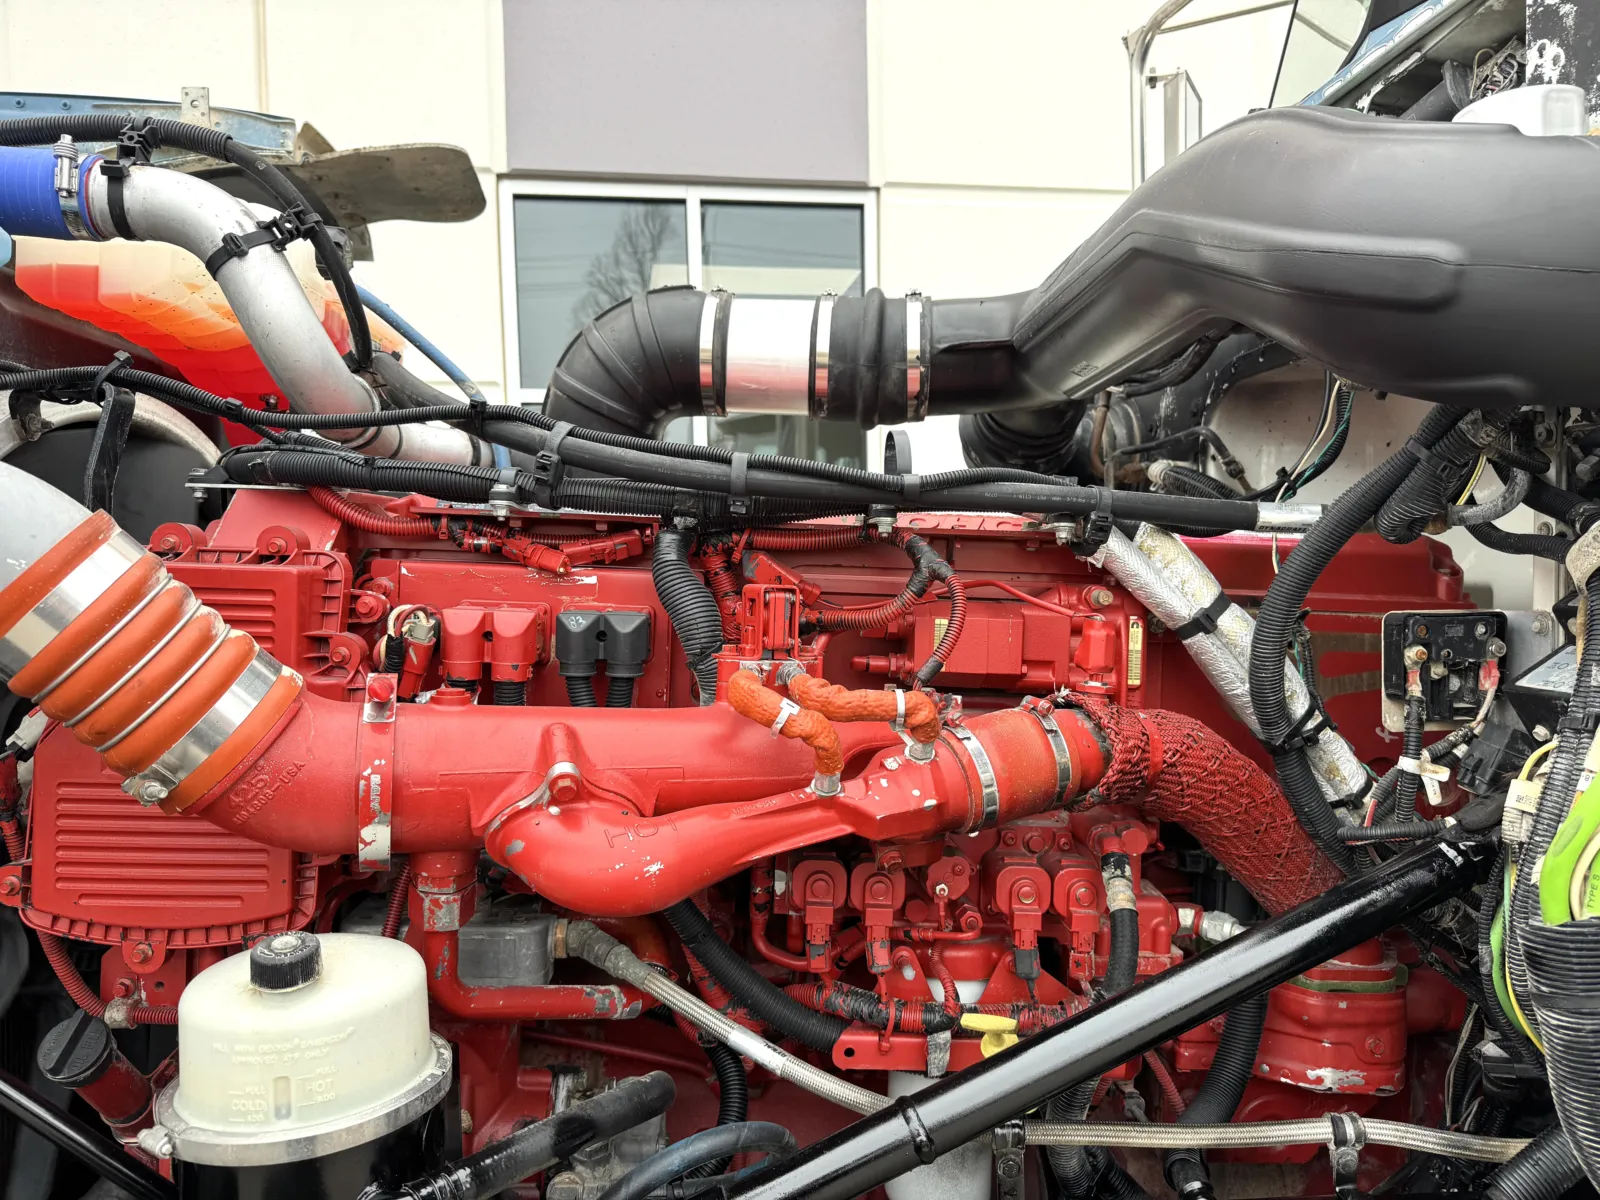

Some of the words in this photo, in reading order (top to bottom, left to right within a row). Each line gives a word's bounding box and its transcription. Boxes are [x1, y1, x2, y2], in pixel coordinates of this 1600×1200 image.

[603, 816, 678, 849] HOT
[1592, 873, 1600, 881] S
[1587, 881, 1598, 908] TYPE
[83, 1028, 105, 1050] FILL
[305, 1047, 330, 1060] ONLY
[316, 1065, 339, 1076] FULL
[245, 1085, 266, 1096] FULL
[307, 1078, 333, 1093] HOT
[316, 1092, 336, 1103] ADD
[231, 1099, 266, 1112] COLD
[246, 1114, 264, 1122] ADD
